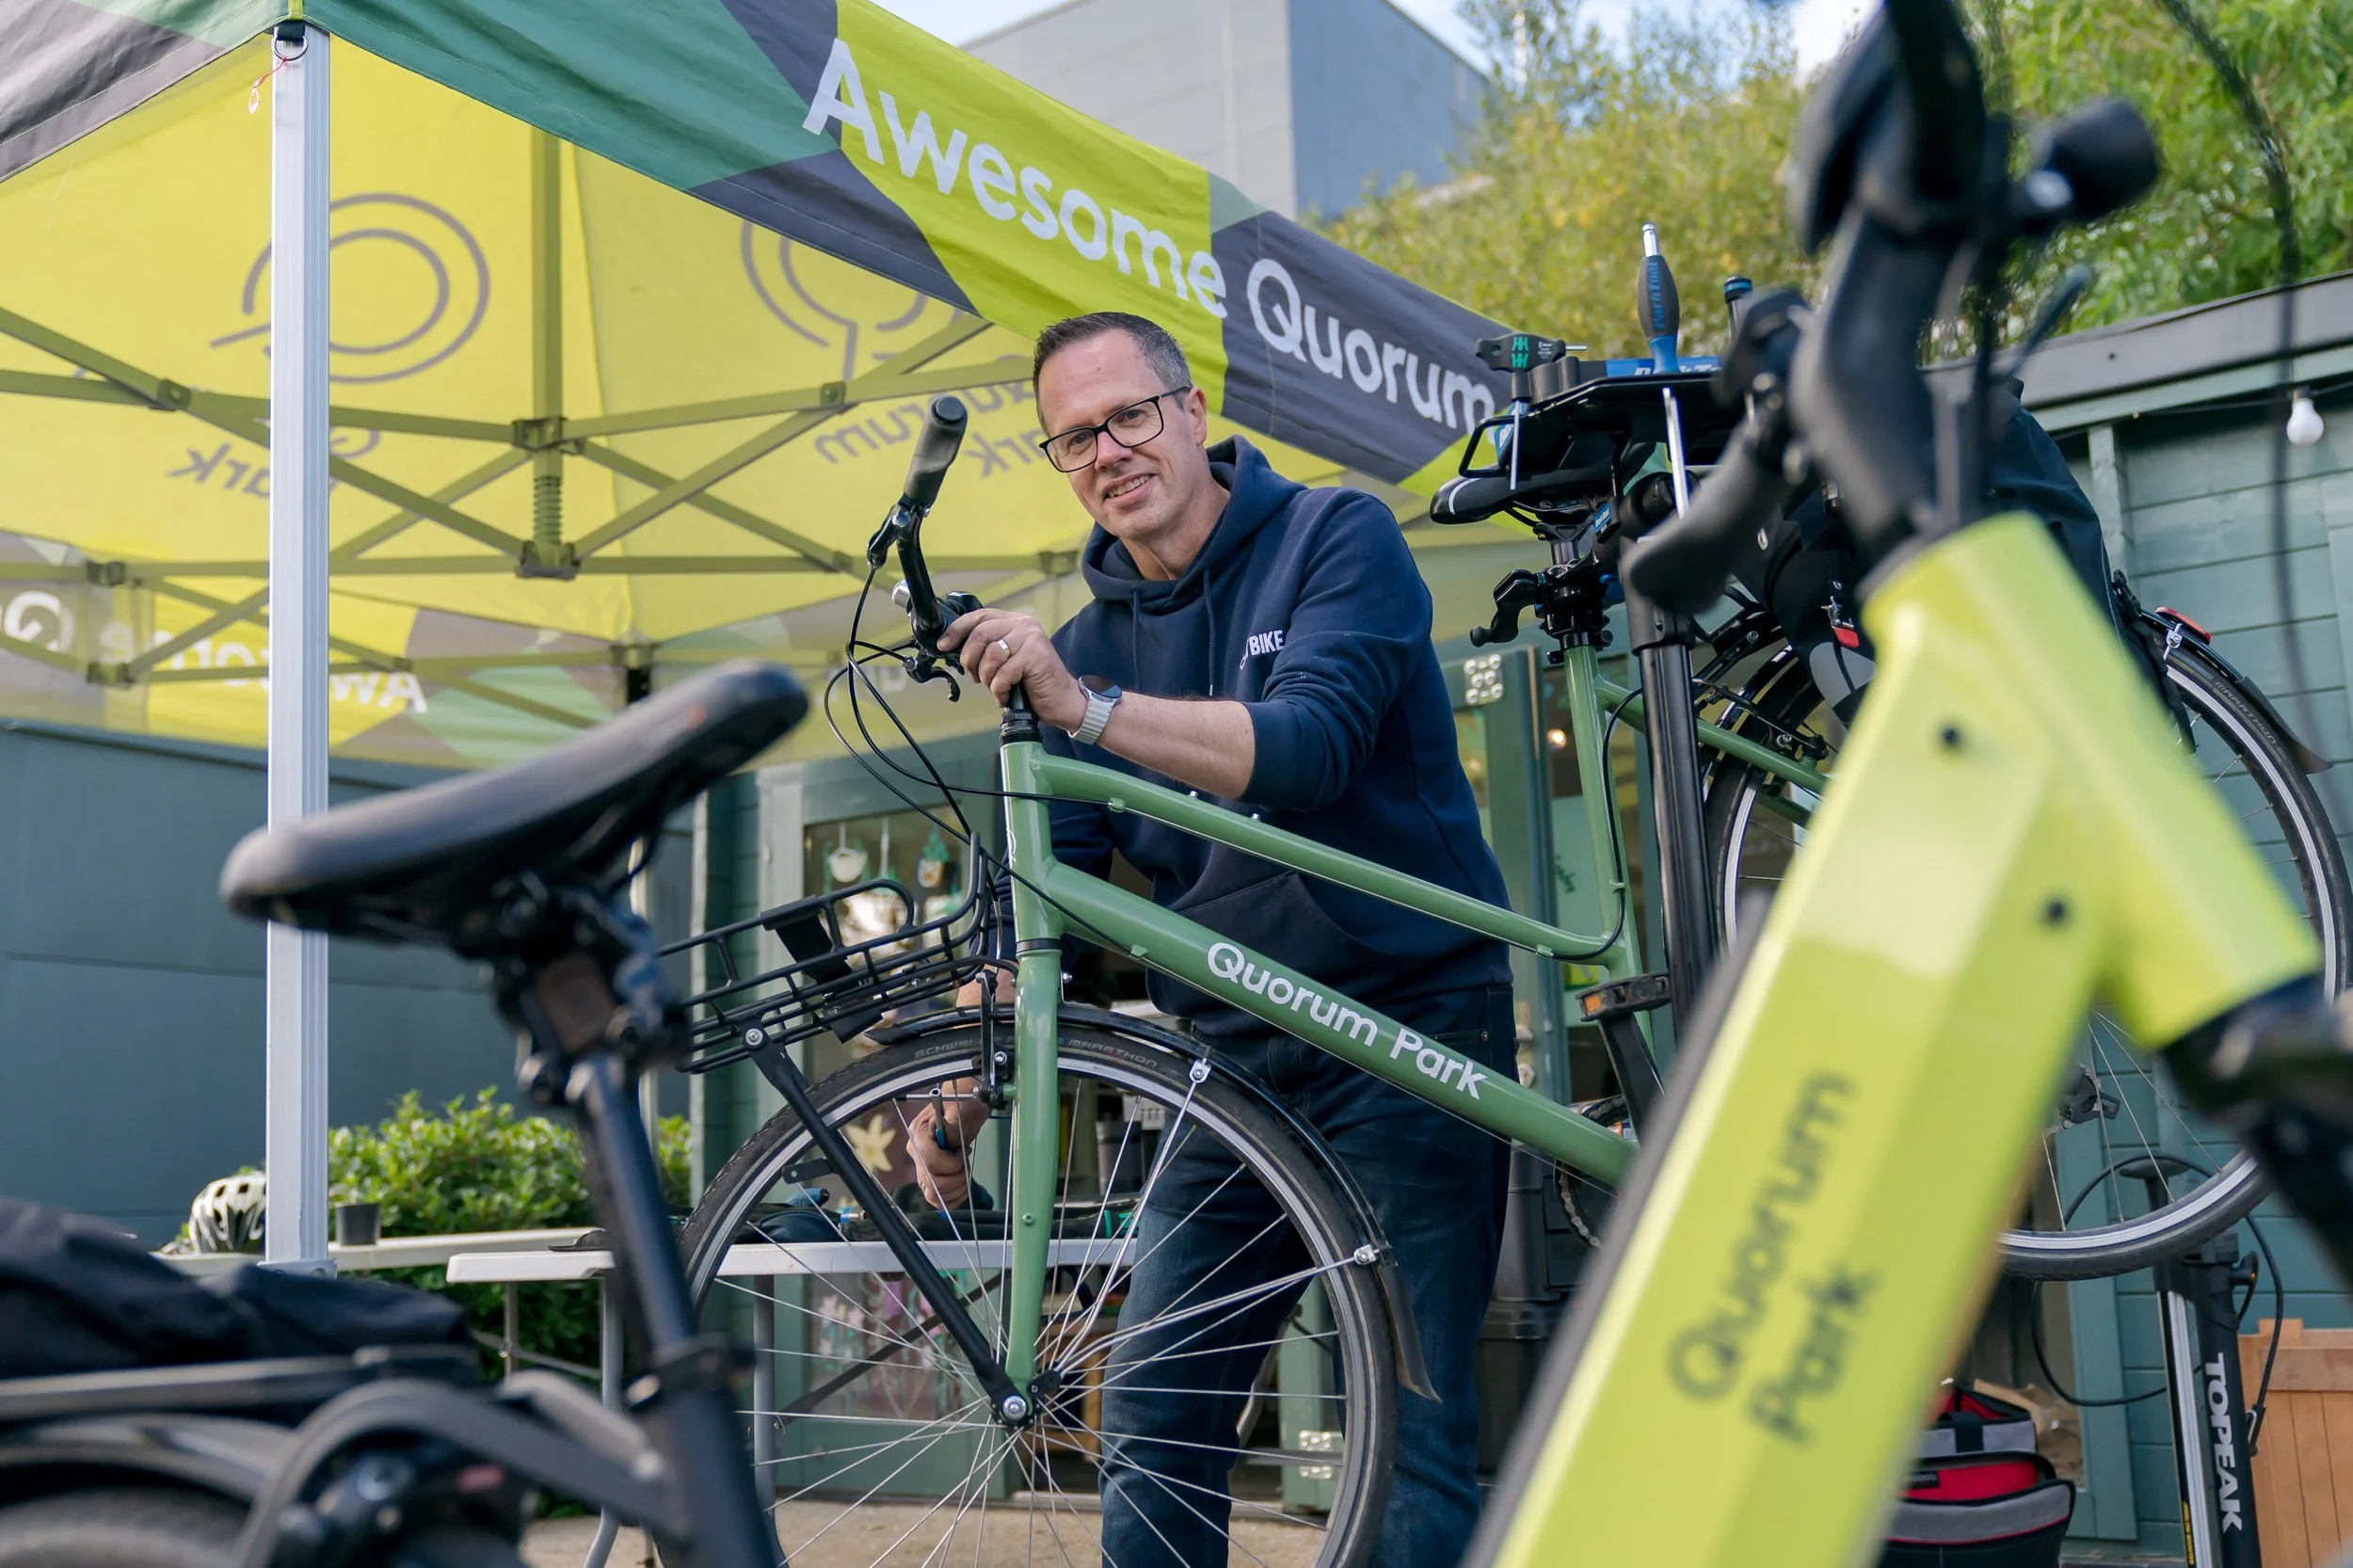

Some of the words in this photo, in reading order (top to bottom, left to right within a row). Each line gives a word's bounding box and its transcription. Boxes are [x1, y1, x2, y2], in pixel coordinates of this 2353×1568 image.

[802, 38, 1228, 319] Awesome
[1247, 258, 1498, 446] Quorum
[2215, 680, 2278, 745] MARATHON
[914, 1038, 975, 1059] SCHWAL
[1069, 1038, 1159, 1068] MARATHON
[1207, 941, 1378, 1048] Quorum
[1388, 1027, 1488, 1100] Park
[1666, 1069, 1856, 1400] Quorum
[1746, 1264, 1881, 1449] Park
[2205, 1352, 2242, 1534] TOPEAK
